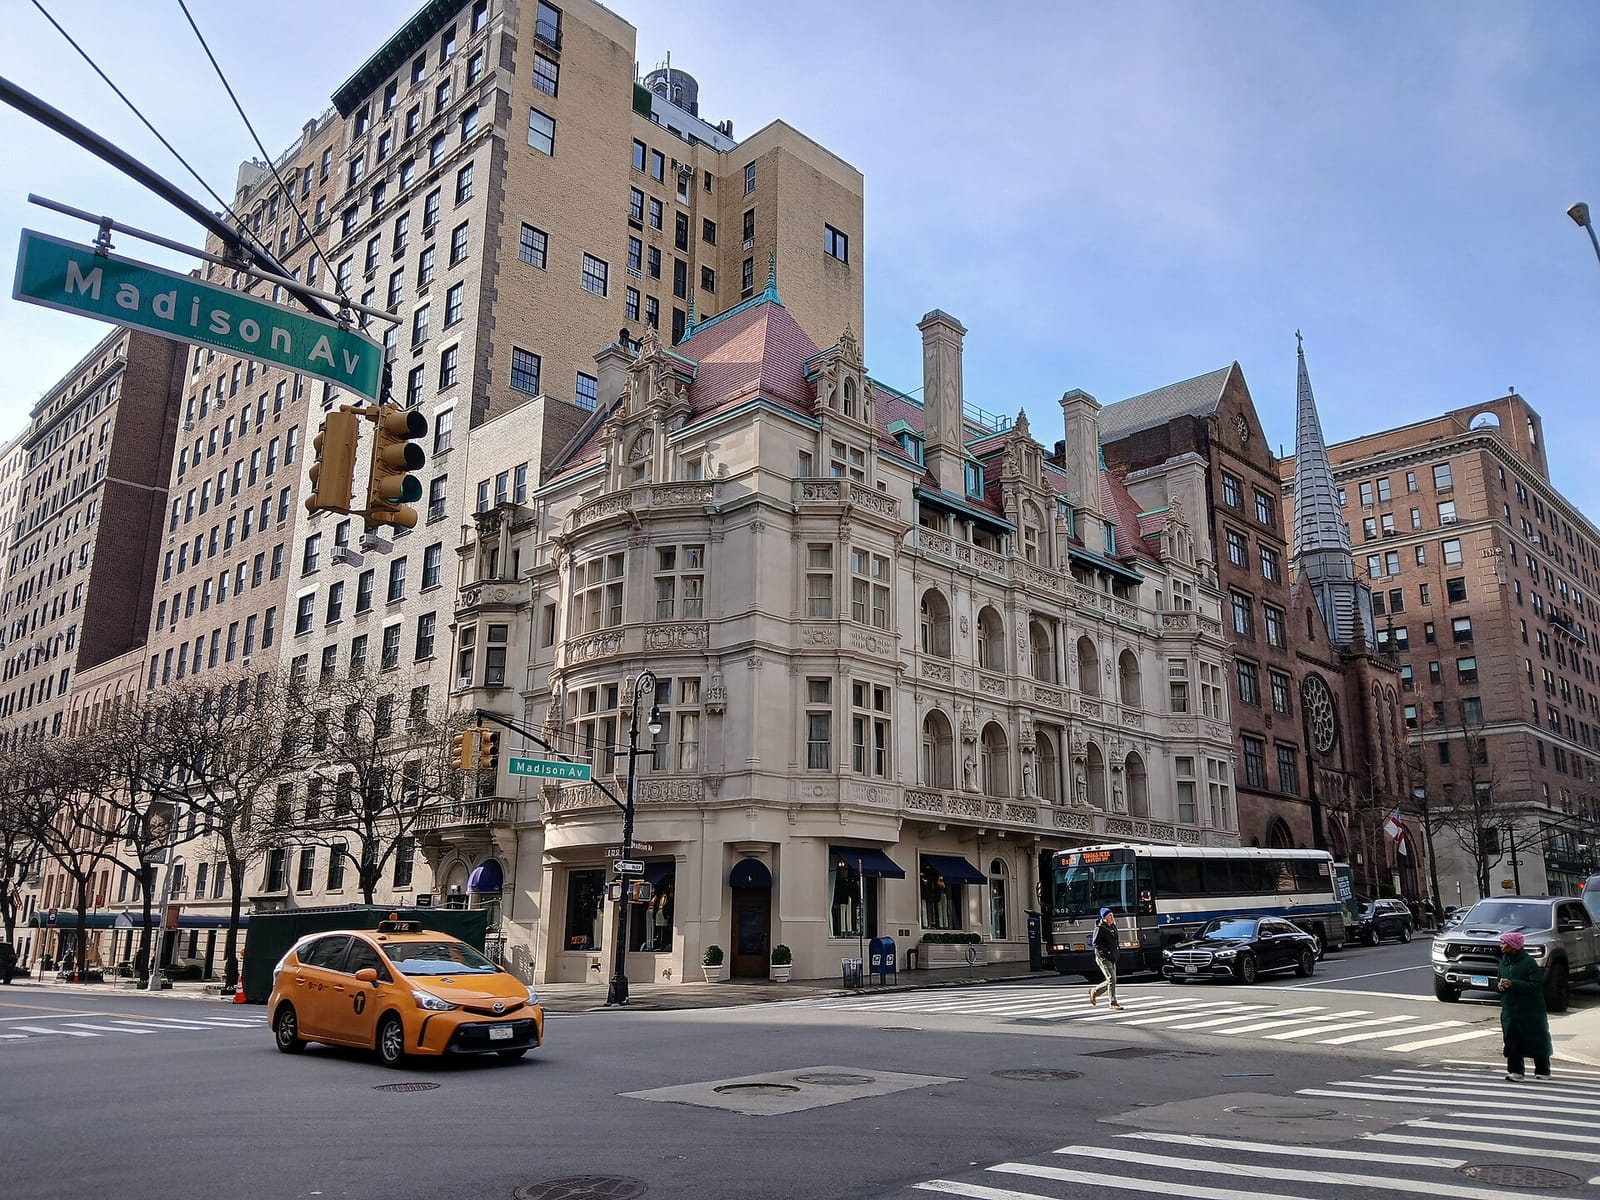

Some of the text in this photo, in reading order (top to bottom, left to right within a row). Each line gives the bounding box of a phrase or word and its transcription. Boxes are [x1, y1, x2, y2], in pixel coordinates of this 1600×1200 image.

[64, 260, 361, 375] Madison Av
[516, 761, 583, 777] Madison Av
